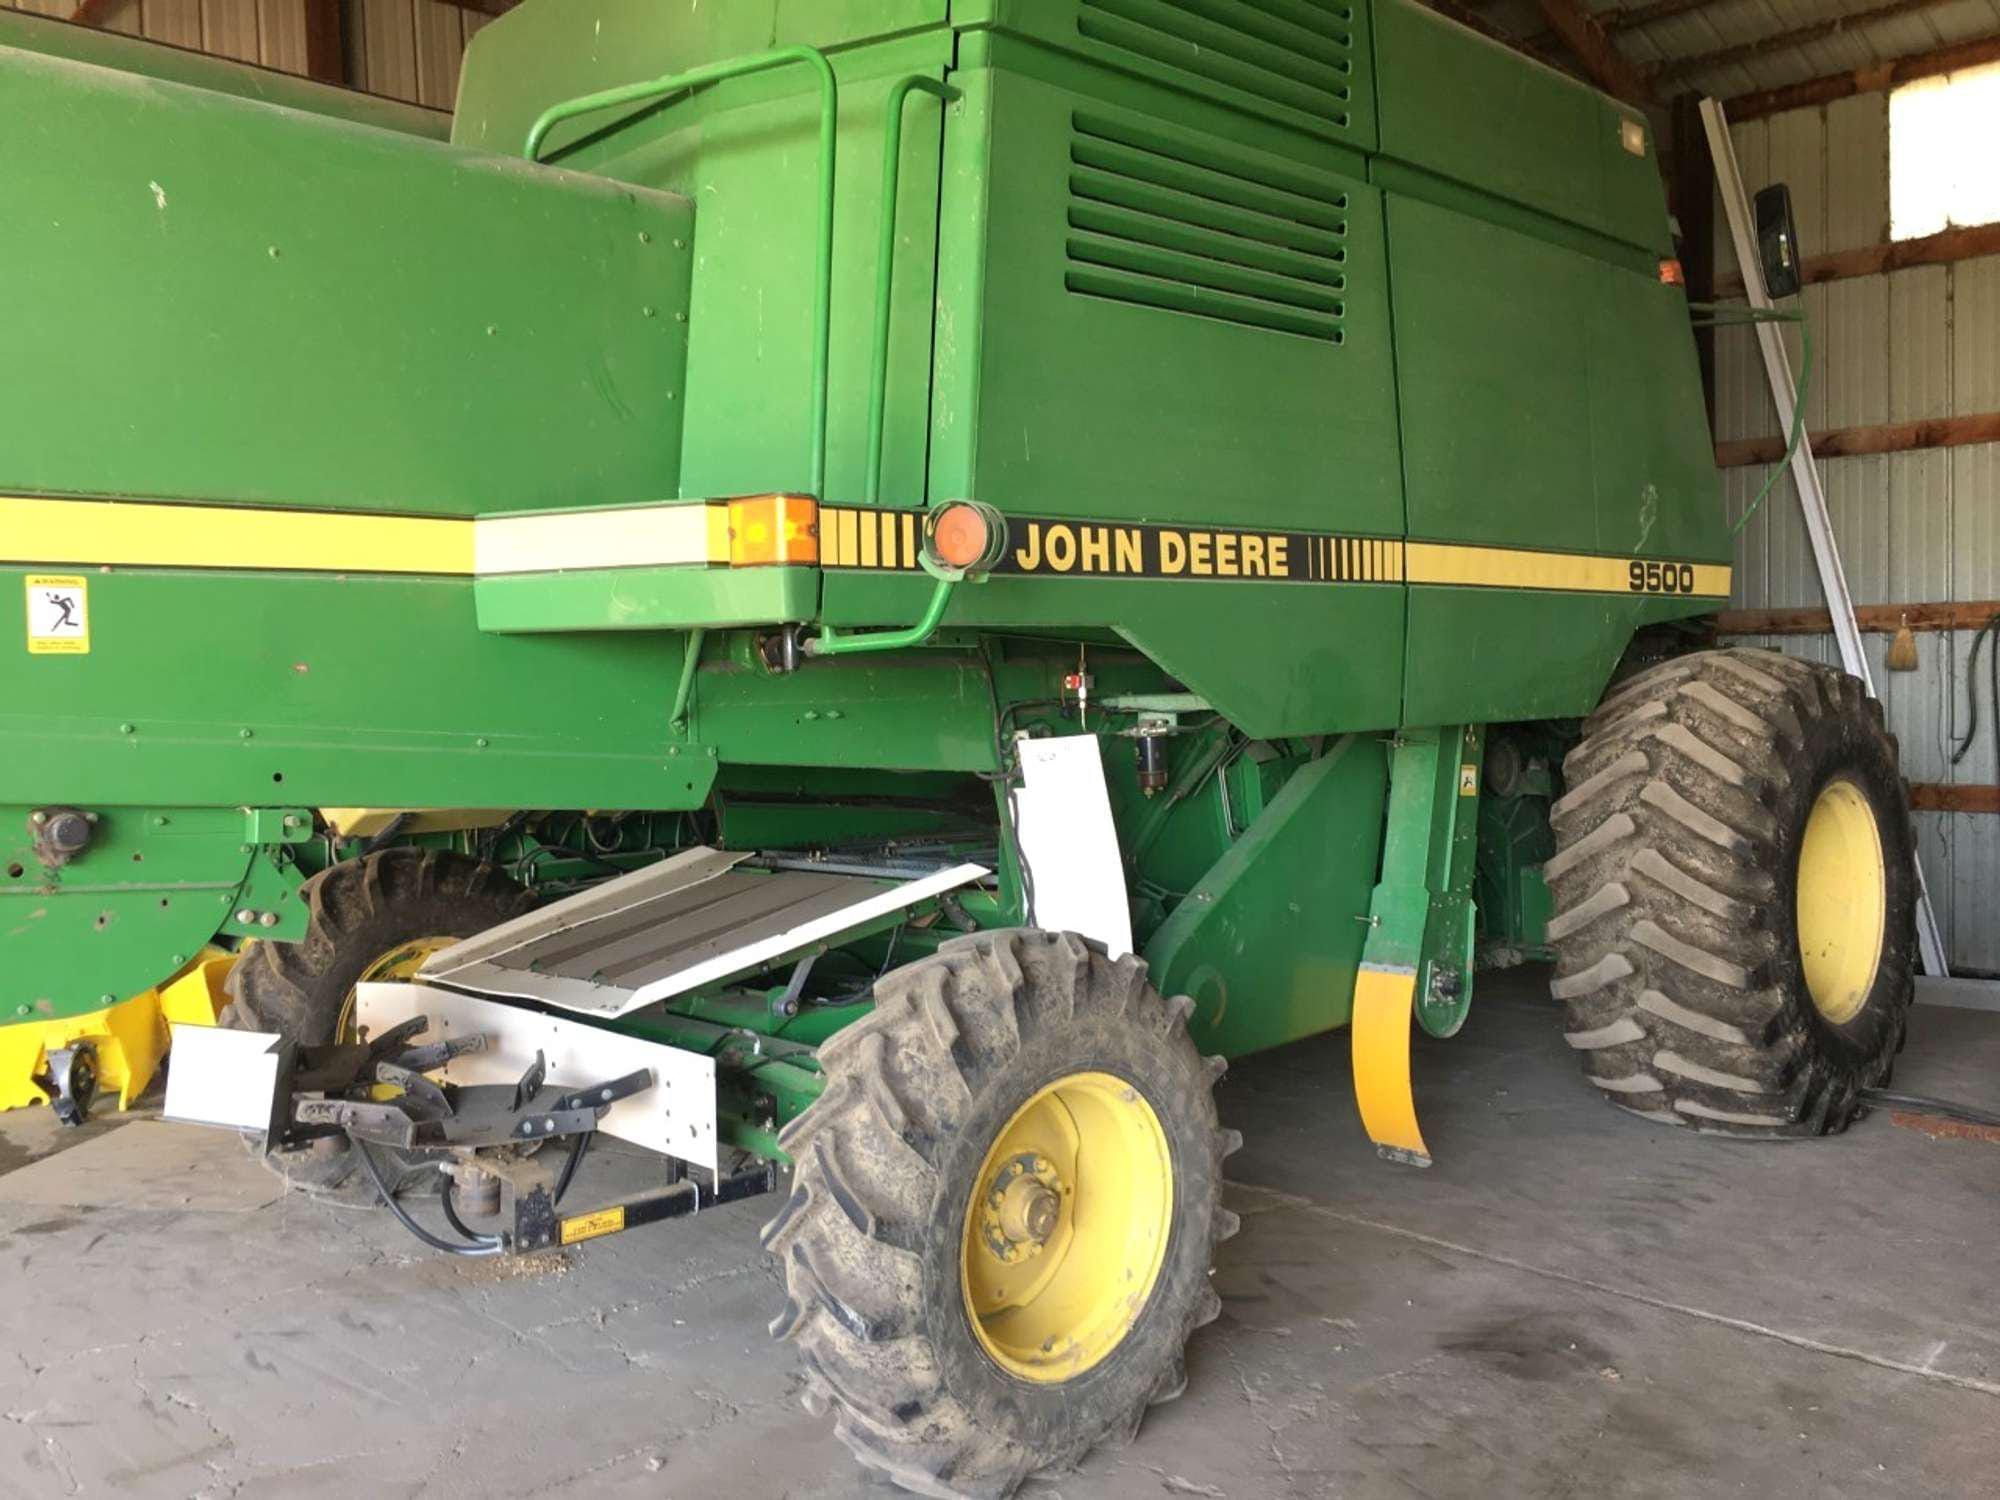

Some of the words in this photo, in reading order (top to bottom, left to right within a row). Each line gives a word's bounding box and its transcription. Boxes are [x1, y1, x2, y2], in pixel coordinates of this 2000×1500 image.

[1016, 523, 1143, 574] JOHN
[1159, 530, 1289, 576] DEERE
[1629, 561, 1694, 593] 9500
